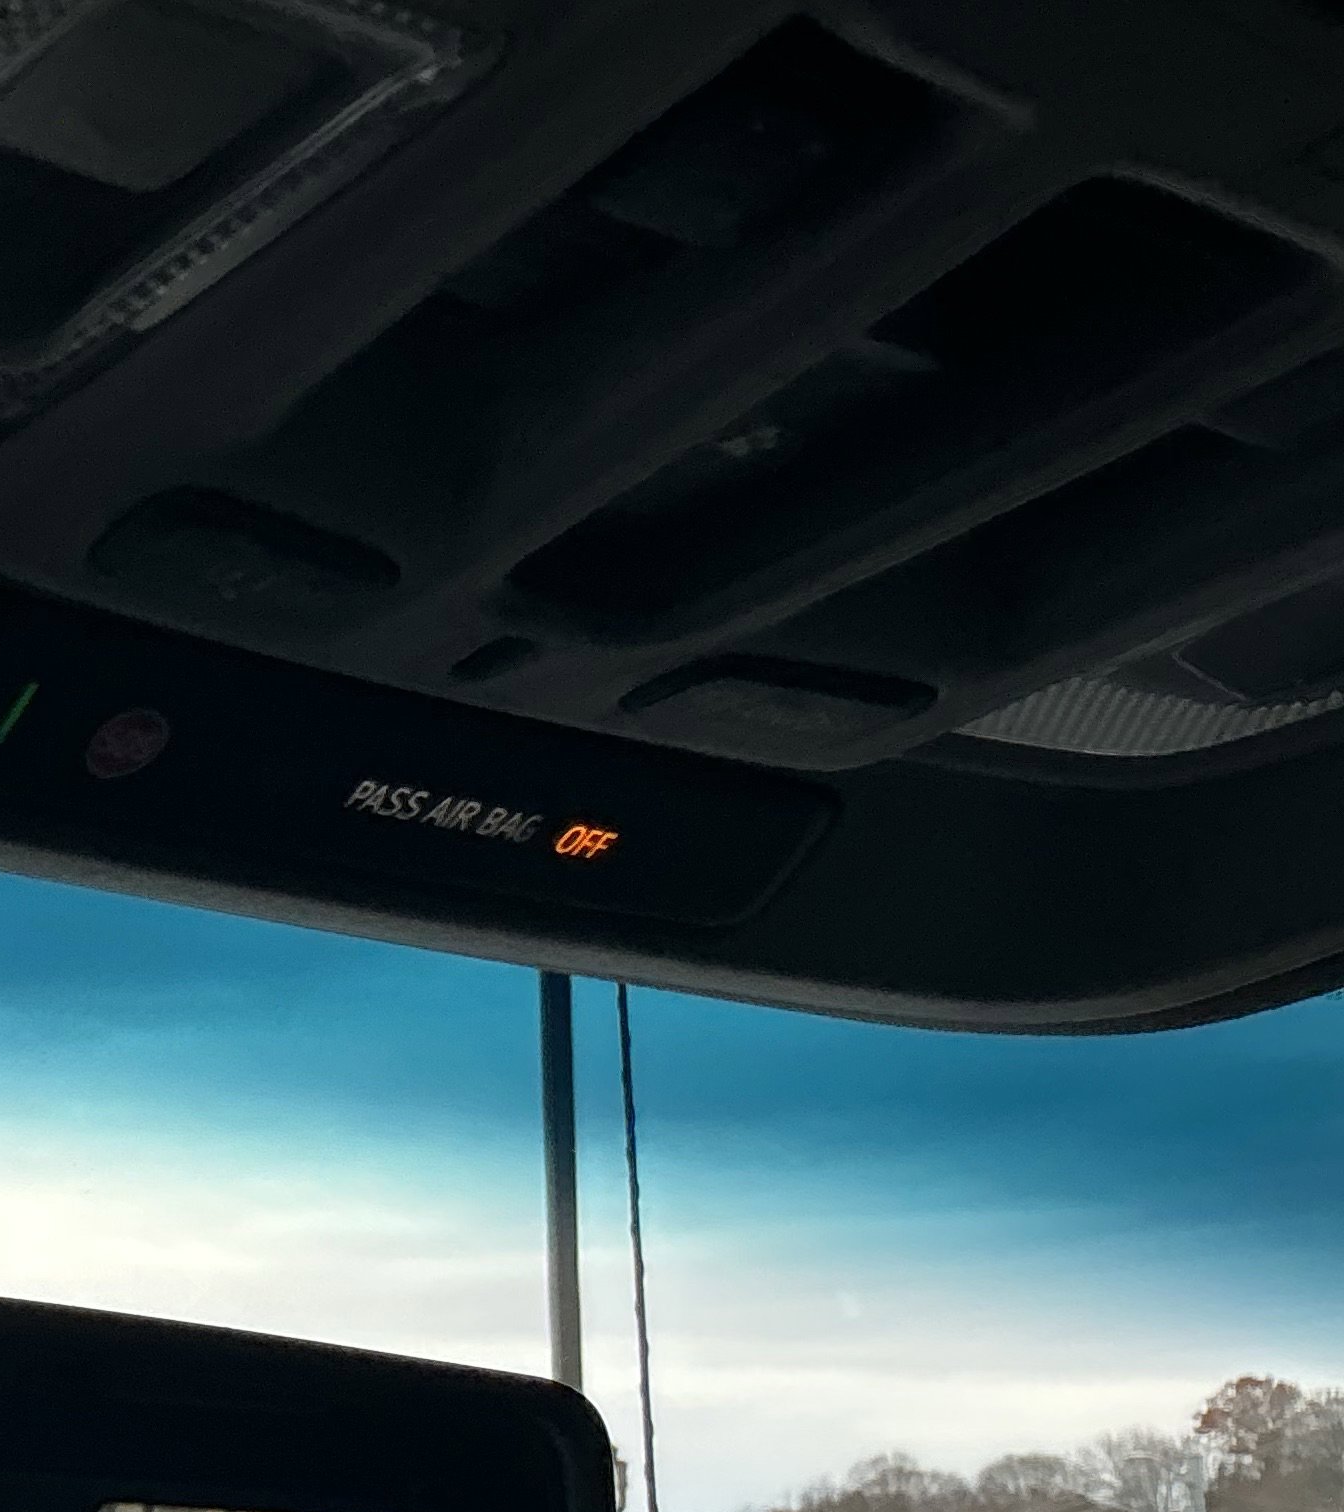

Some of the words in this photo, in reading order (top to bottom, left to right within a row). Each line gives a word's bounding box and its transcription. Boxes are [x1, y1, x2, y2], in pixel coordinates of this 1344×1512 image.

[343, 779, 431, 821] PASS
[419, 796, 482, 832] AIR
[475, 807, 545, 843] BAG
[554, 824, 620, 859] OFF
